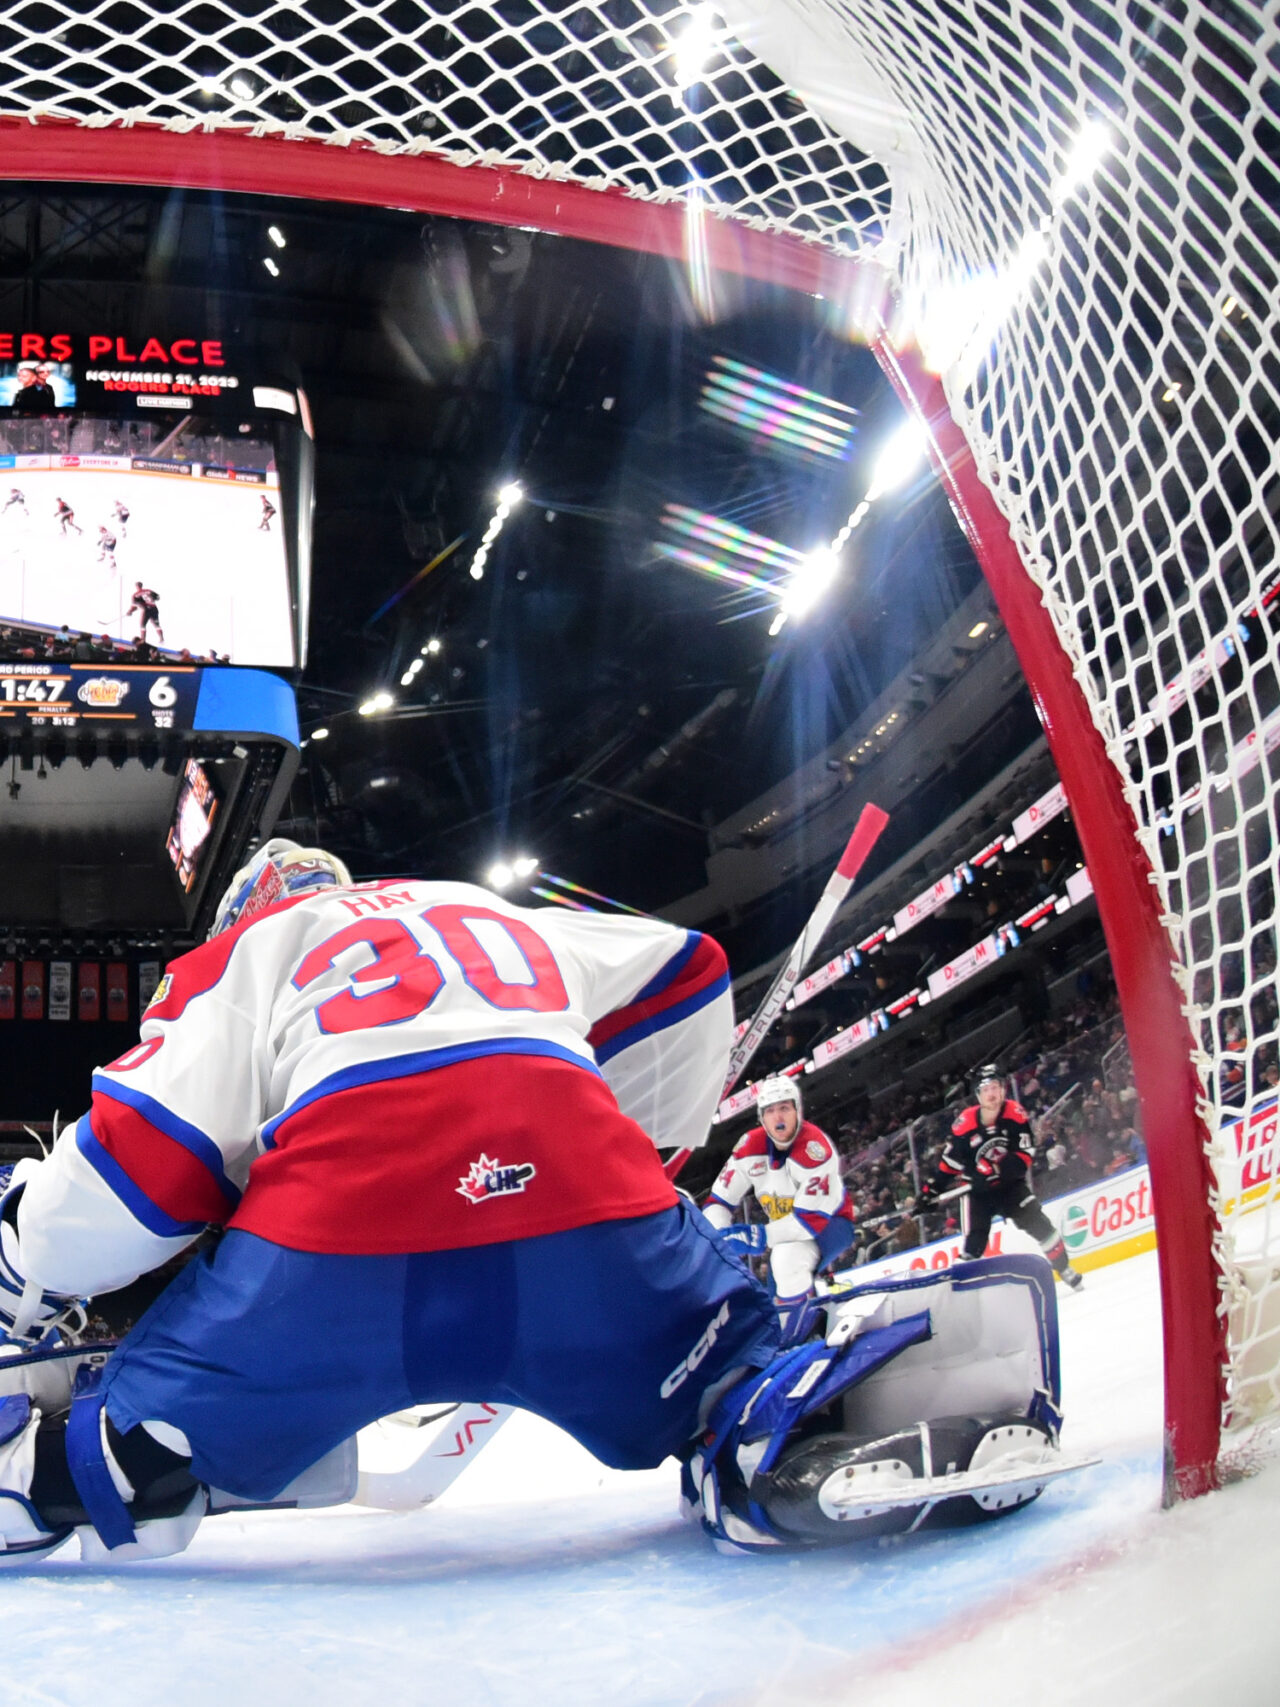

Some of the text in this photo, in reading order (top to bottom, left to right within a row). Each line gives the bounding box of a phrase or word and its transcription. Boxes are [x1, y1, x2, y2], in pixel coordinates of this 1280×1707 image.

[89, 335, 226, 366] PLACE
[85, 370, 173, 384] NOVEMBER
[198, 374, 239, 388] 2023
[103, 380, 222, 396] ROGERS PLACE
[14, 665, 53, 675] PERIOD
[148, 676, 178, 708] 6
[154, 716, 173, 728] 32
[338, 890, 417, 917] HAY
[291, 903, 571, 1035] 30
[805, 1174, 830, 1197] 24
[659, 1299, 731, 1400] CCM
